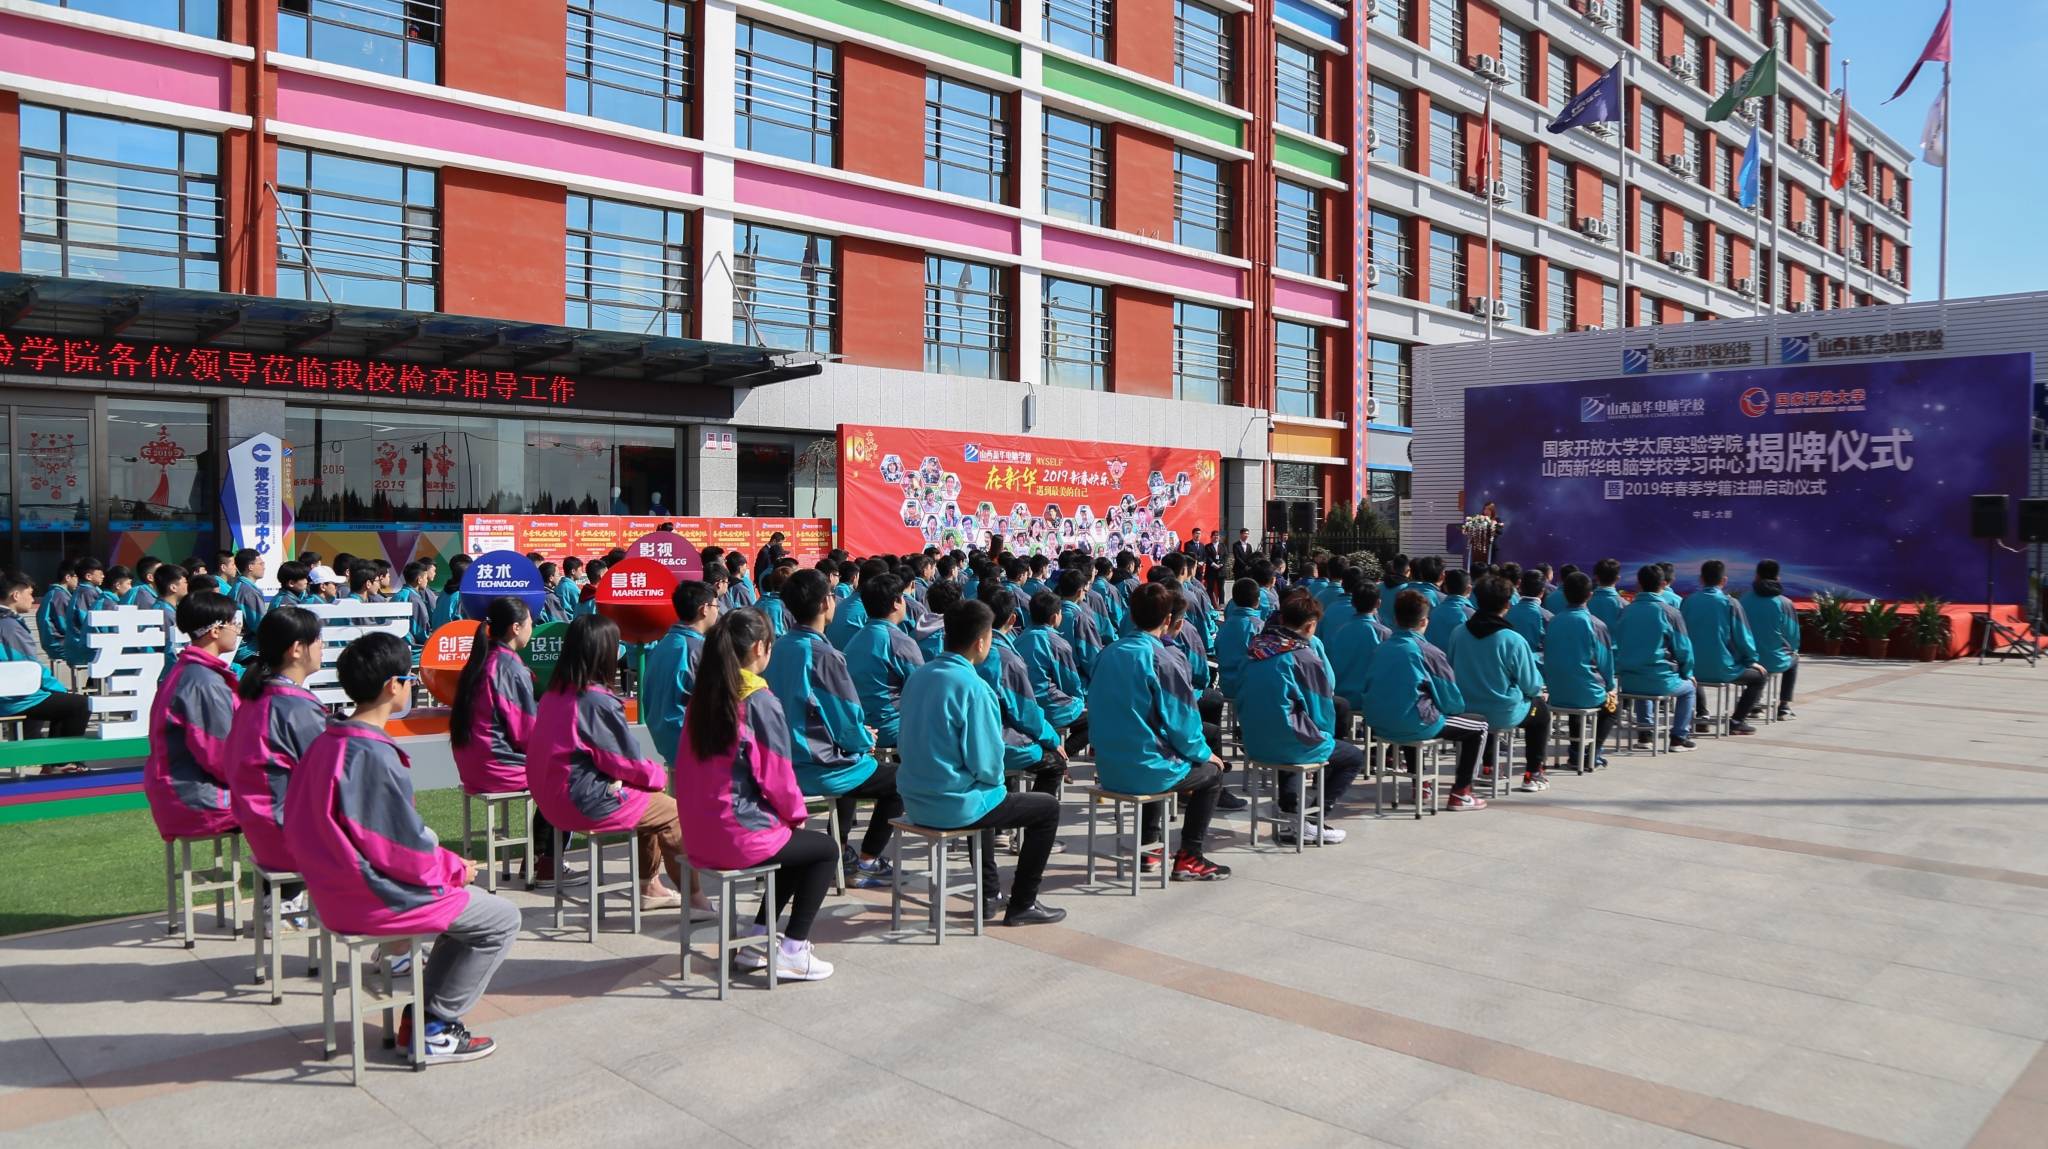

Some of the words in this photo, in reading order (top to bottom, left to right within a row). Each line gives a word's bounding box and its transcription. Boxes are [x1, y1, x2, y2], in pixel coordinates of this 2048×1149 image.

[1775, 389, 1866, 408] 国家开放大学
[1607, 398, 1705, 415] 山西新华电脑学校
[1543, 434, 1743, 458] 国家开放大学太原实验学院
[1746, 427, 1914, 474] 揭牌仪式
[322, 464, 345, 474] 2019
[1036, 457, 1063, 466] MYSELF
[1542, 455, 1744, 477] 山西新华电脑学校学习中心
[985, 465, 1037, 495] 在新华
[1043, 470, 1067, 482] 2019
[374, 480, 405, 489] 2019
[254, 466, 270, 555] 报名咨询中心
[640, 543, 672, 557] 影视
[477, 564, 511, 579] 技术
[476, 580, 530, 588] TECHNOLOGY
[612, 572, 646, 588] 营销
[612, 589, 664, 597] MARKETING
[439, 636, 474, 652] 创客
[531, 637, 564, 652] 设计
